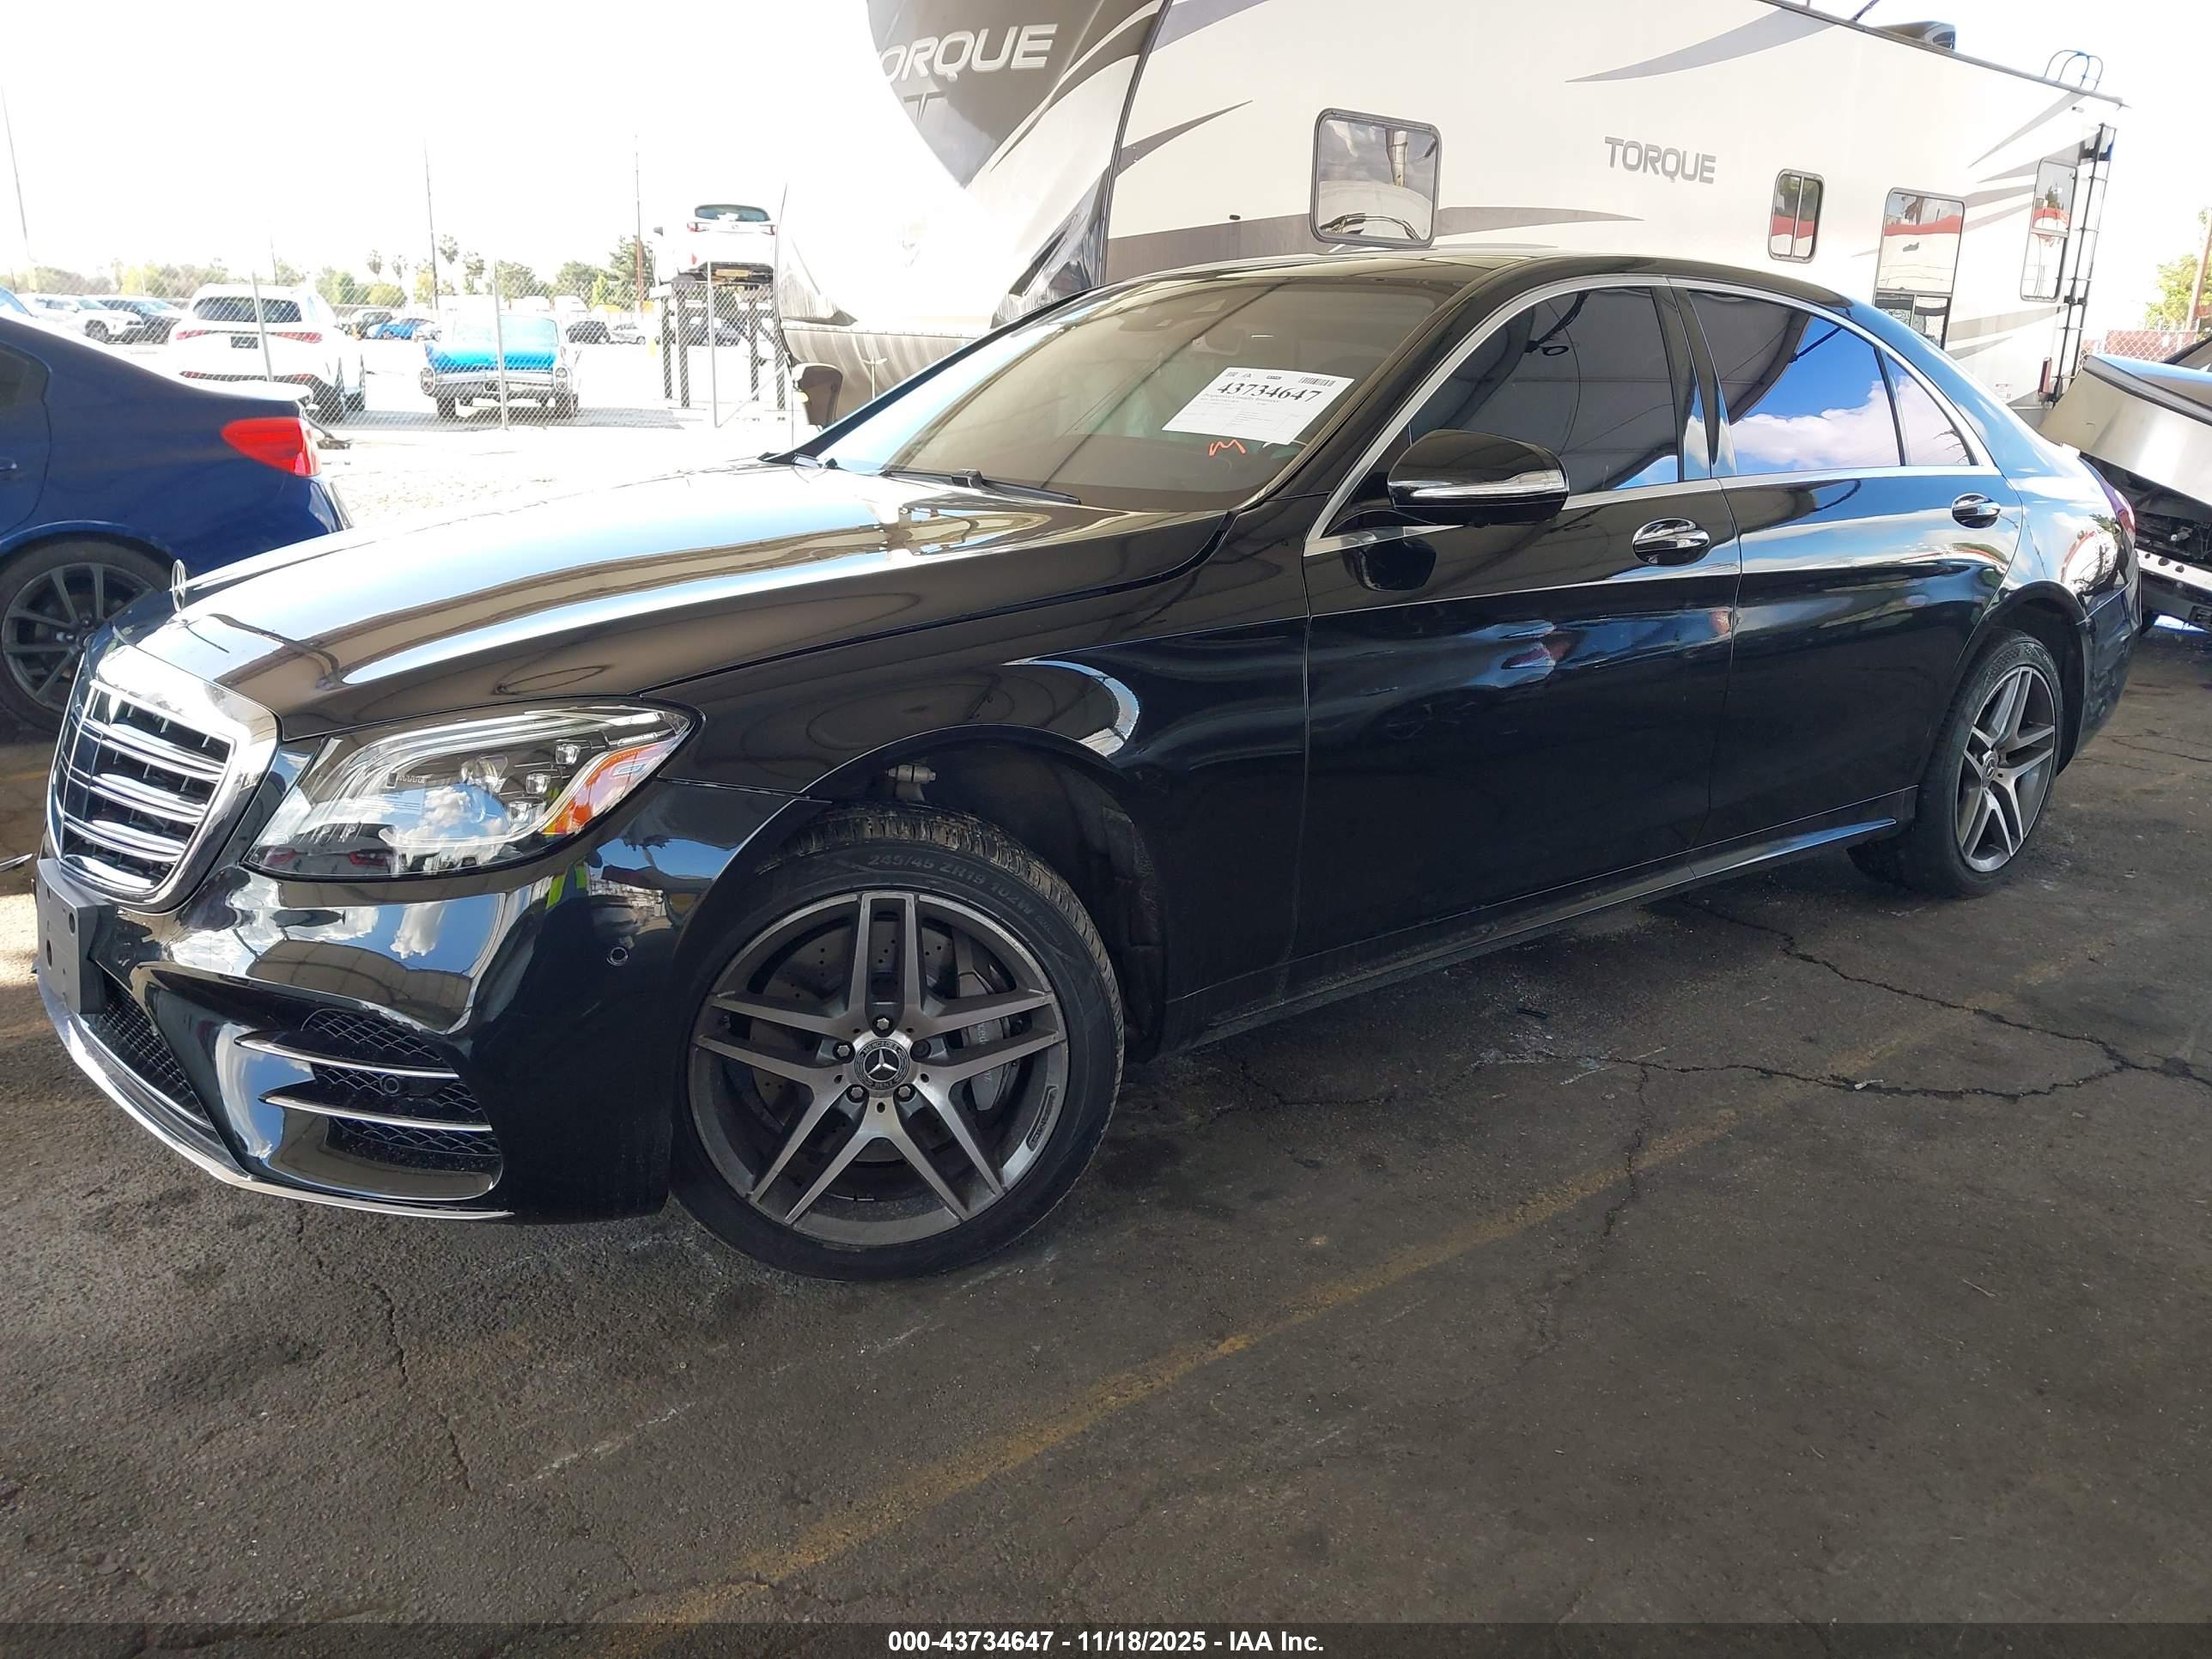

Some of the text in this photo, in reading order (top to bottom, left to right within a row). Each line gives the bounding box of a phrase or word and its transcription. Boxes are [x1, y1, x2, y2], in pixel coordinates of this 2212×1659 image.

[878, 23, 1058, 82] ORQUE
[1604, 136, 1717, 185] TORQUE
[1217, 381, 1323, 403] 43734647
